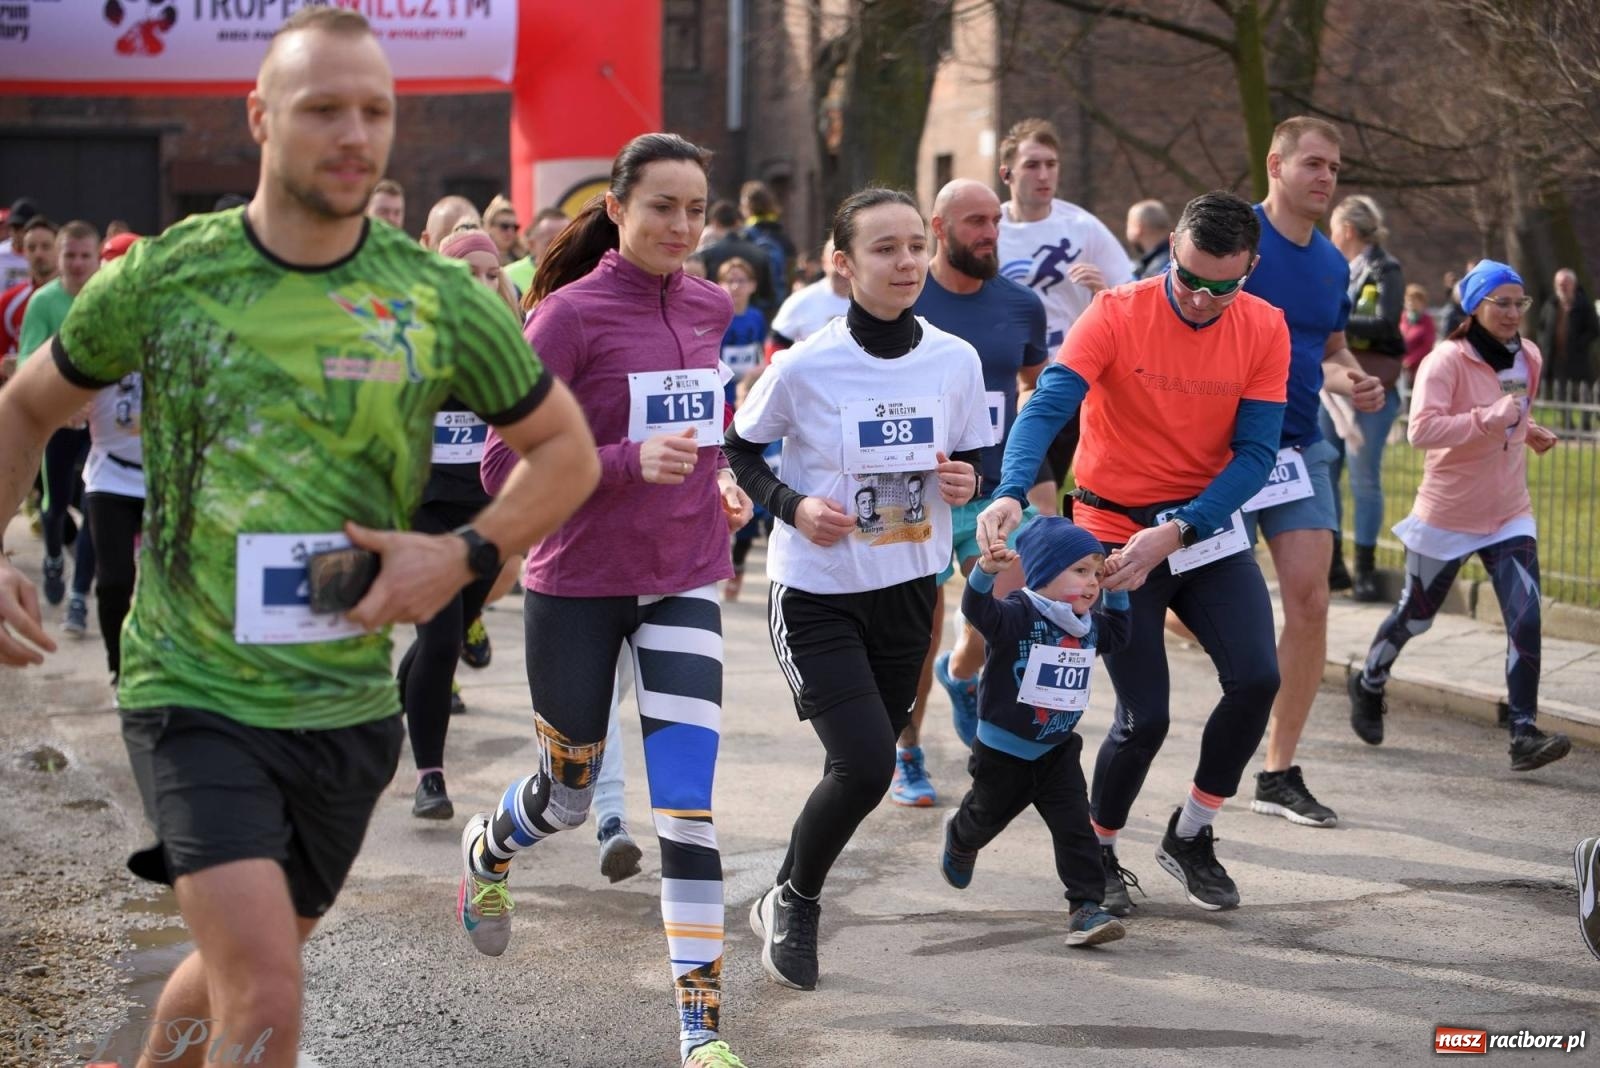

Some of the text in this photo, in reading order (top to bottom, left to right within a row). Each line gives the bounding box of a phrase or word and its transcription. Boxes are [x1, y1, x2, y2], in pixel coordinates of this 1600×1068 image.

[1143, 373, 1242, 397] TRAINING
[663, 393, 705, 421] 115
[888, 406, 917, 416] WILCZYM
[448, 427, 473, 444] 72
[881, 420, 914, 444] 98
[1054, 667, 1085, 689] 101
